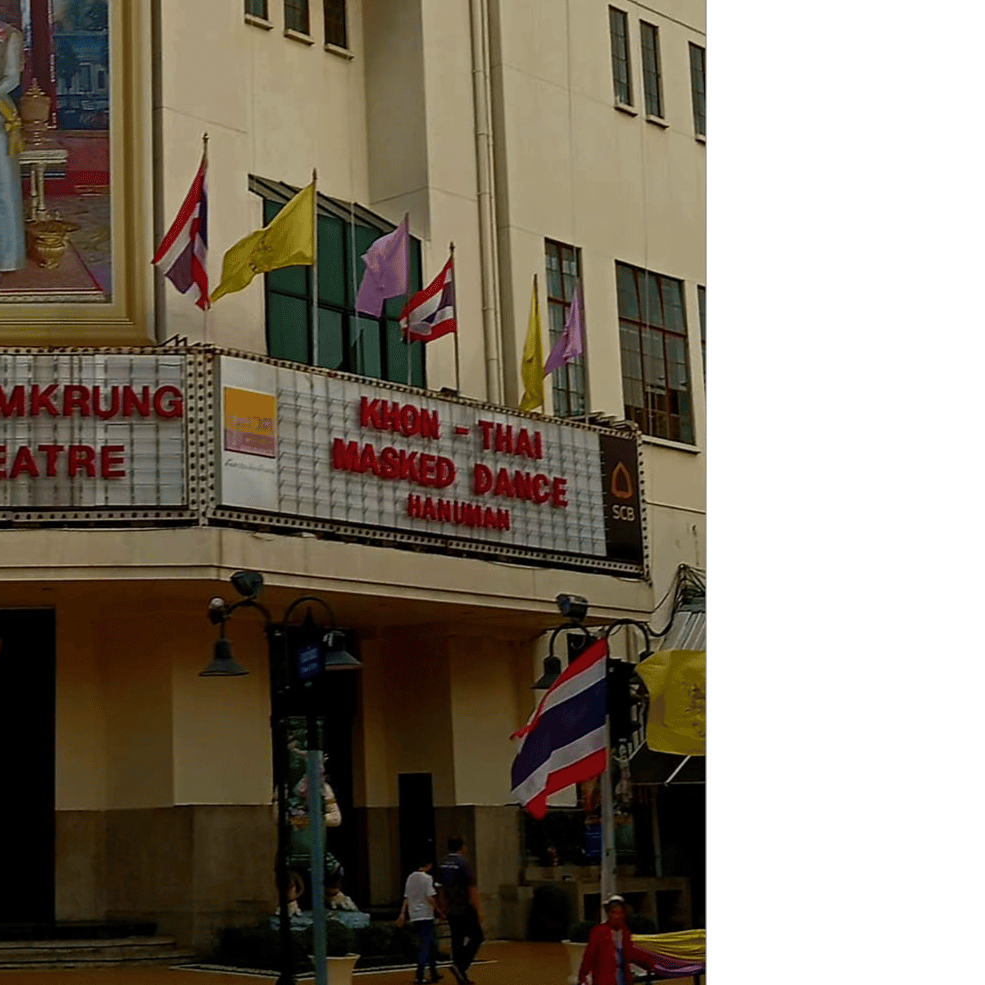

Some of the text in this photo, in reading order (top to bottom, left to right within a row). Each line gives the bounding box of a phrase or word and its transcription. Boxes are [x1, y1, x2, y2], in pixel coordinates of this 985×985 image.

[359, 396, 441, 440] KHON
[477, 420, 543, 460] THAI
[331, 437, 569, 508] MASKED DANCE
[407, 492, 511, 531] HANUMAN
[612, 504, 635, 522] SCB
